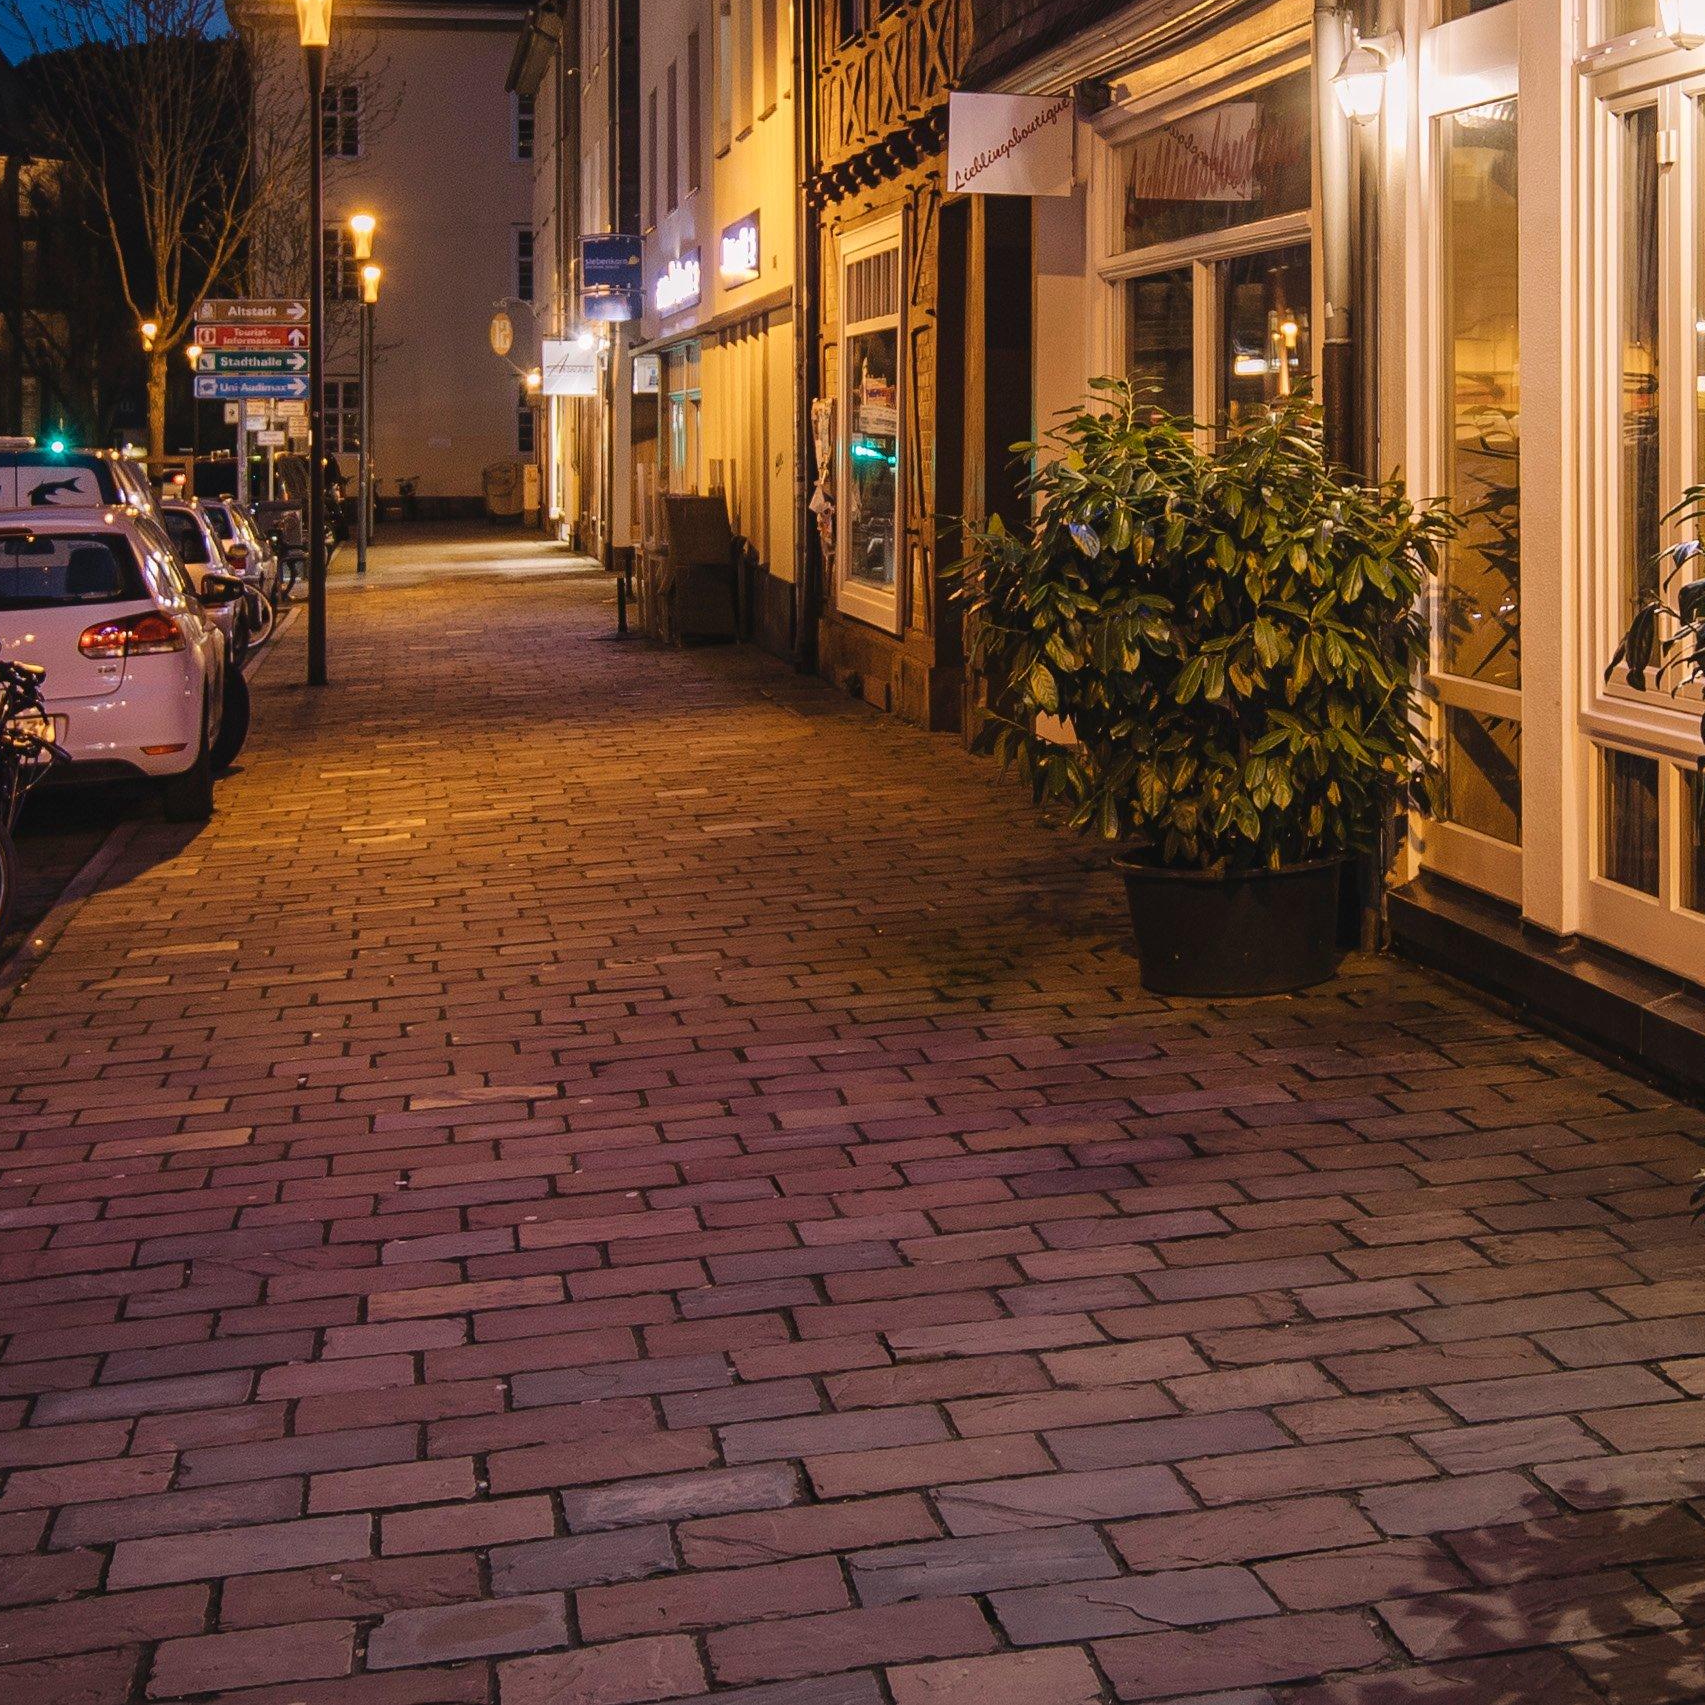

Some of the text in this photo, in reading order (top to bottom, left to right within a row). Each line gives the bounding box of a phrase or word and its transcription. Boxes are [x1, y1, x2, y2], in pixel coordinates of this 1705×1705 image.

[954, 98, 1070, 191] Lieblingsboutique
[227, 305, 277, 317] Altstadt
[223, 336, 281, 345] Information
[219, 356, 283, 367] Stadthalle
